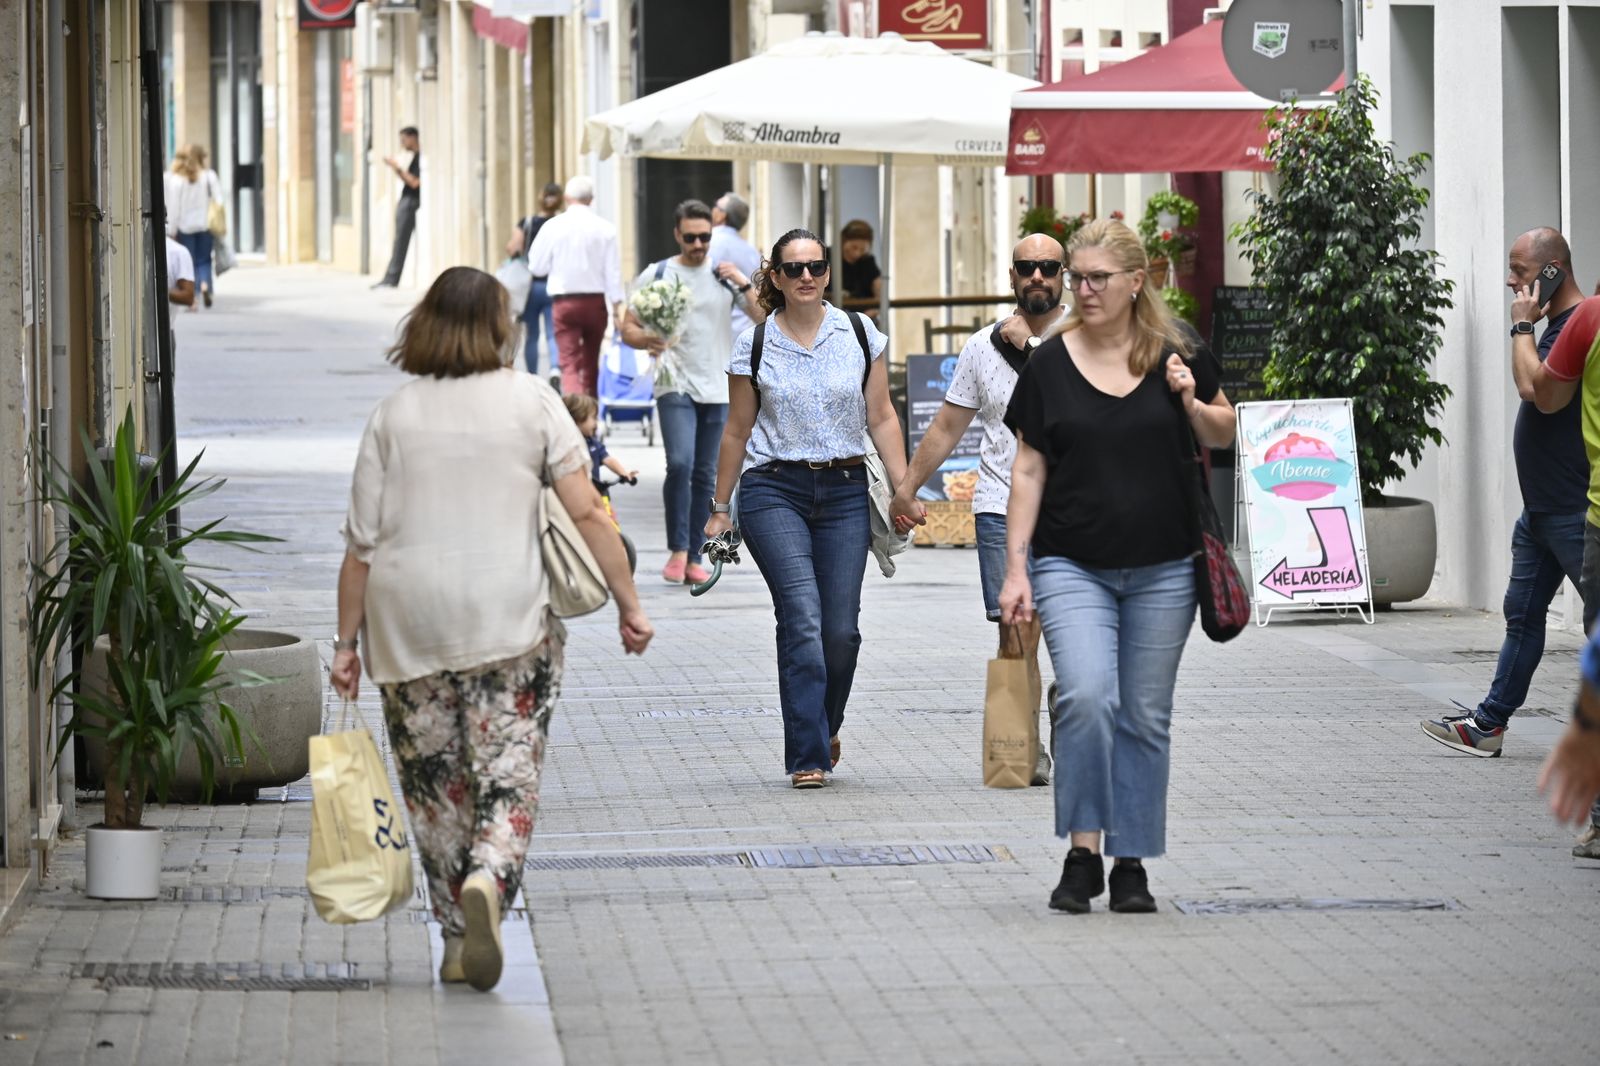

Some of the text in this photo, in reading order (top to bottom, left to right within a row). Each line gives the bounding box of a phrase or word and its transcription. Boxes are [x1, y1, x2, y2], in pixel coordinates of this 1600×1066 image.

[750, 121, 842, 145] Alhambra
[954, 139, 1003, 152] CERVEZA
[1014, 143, 1046, 156] BARCO
[1270, 459, 1332, 481] Abense
[1272, 566, 1357, 587] HELADERÍA
